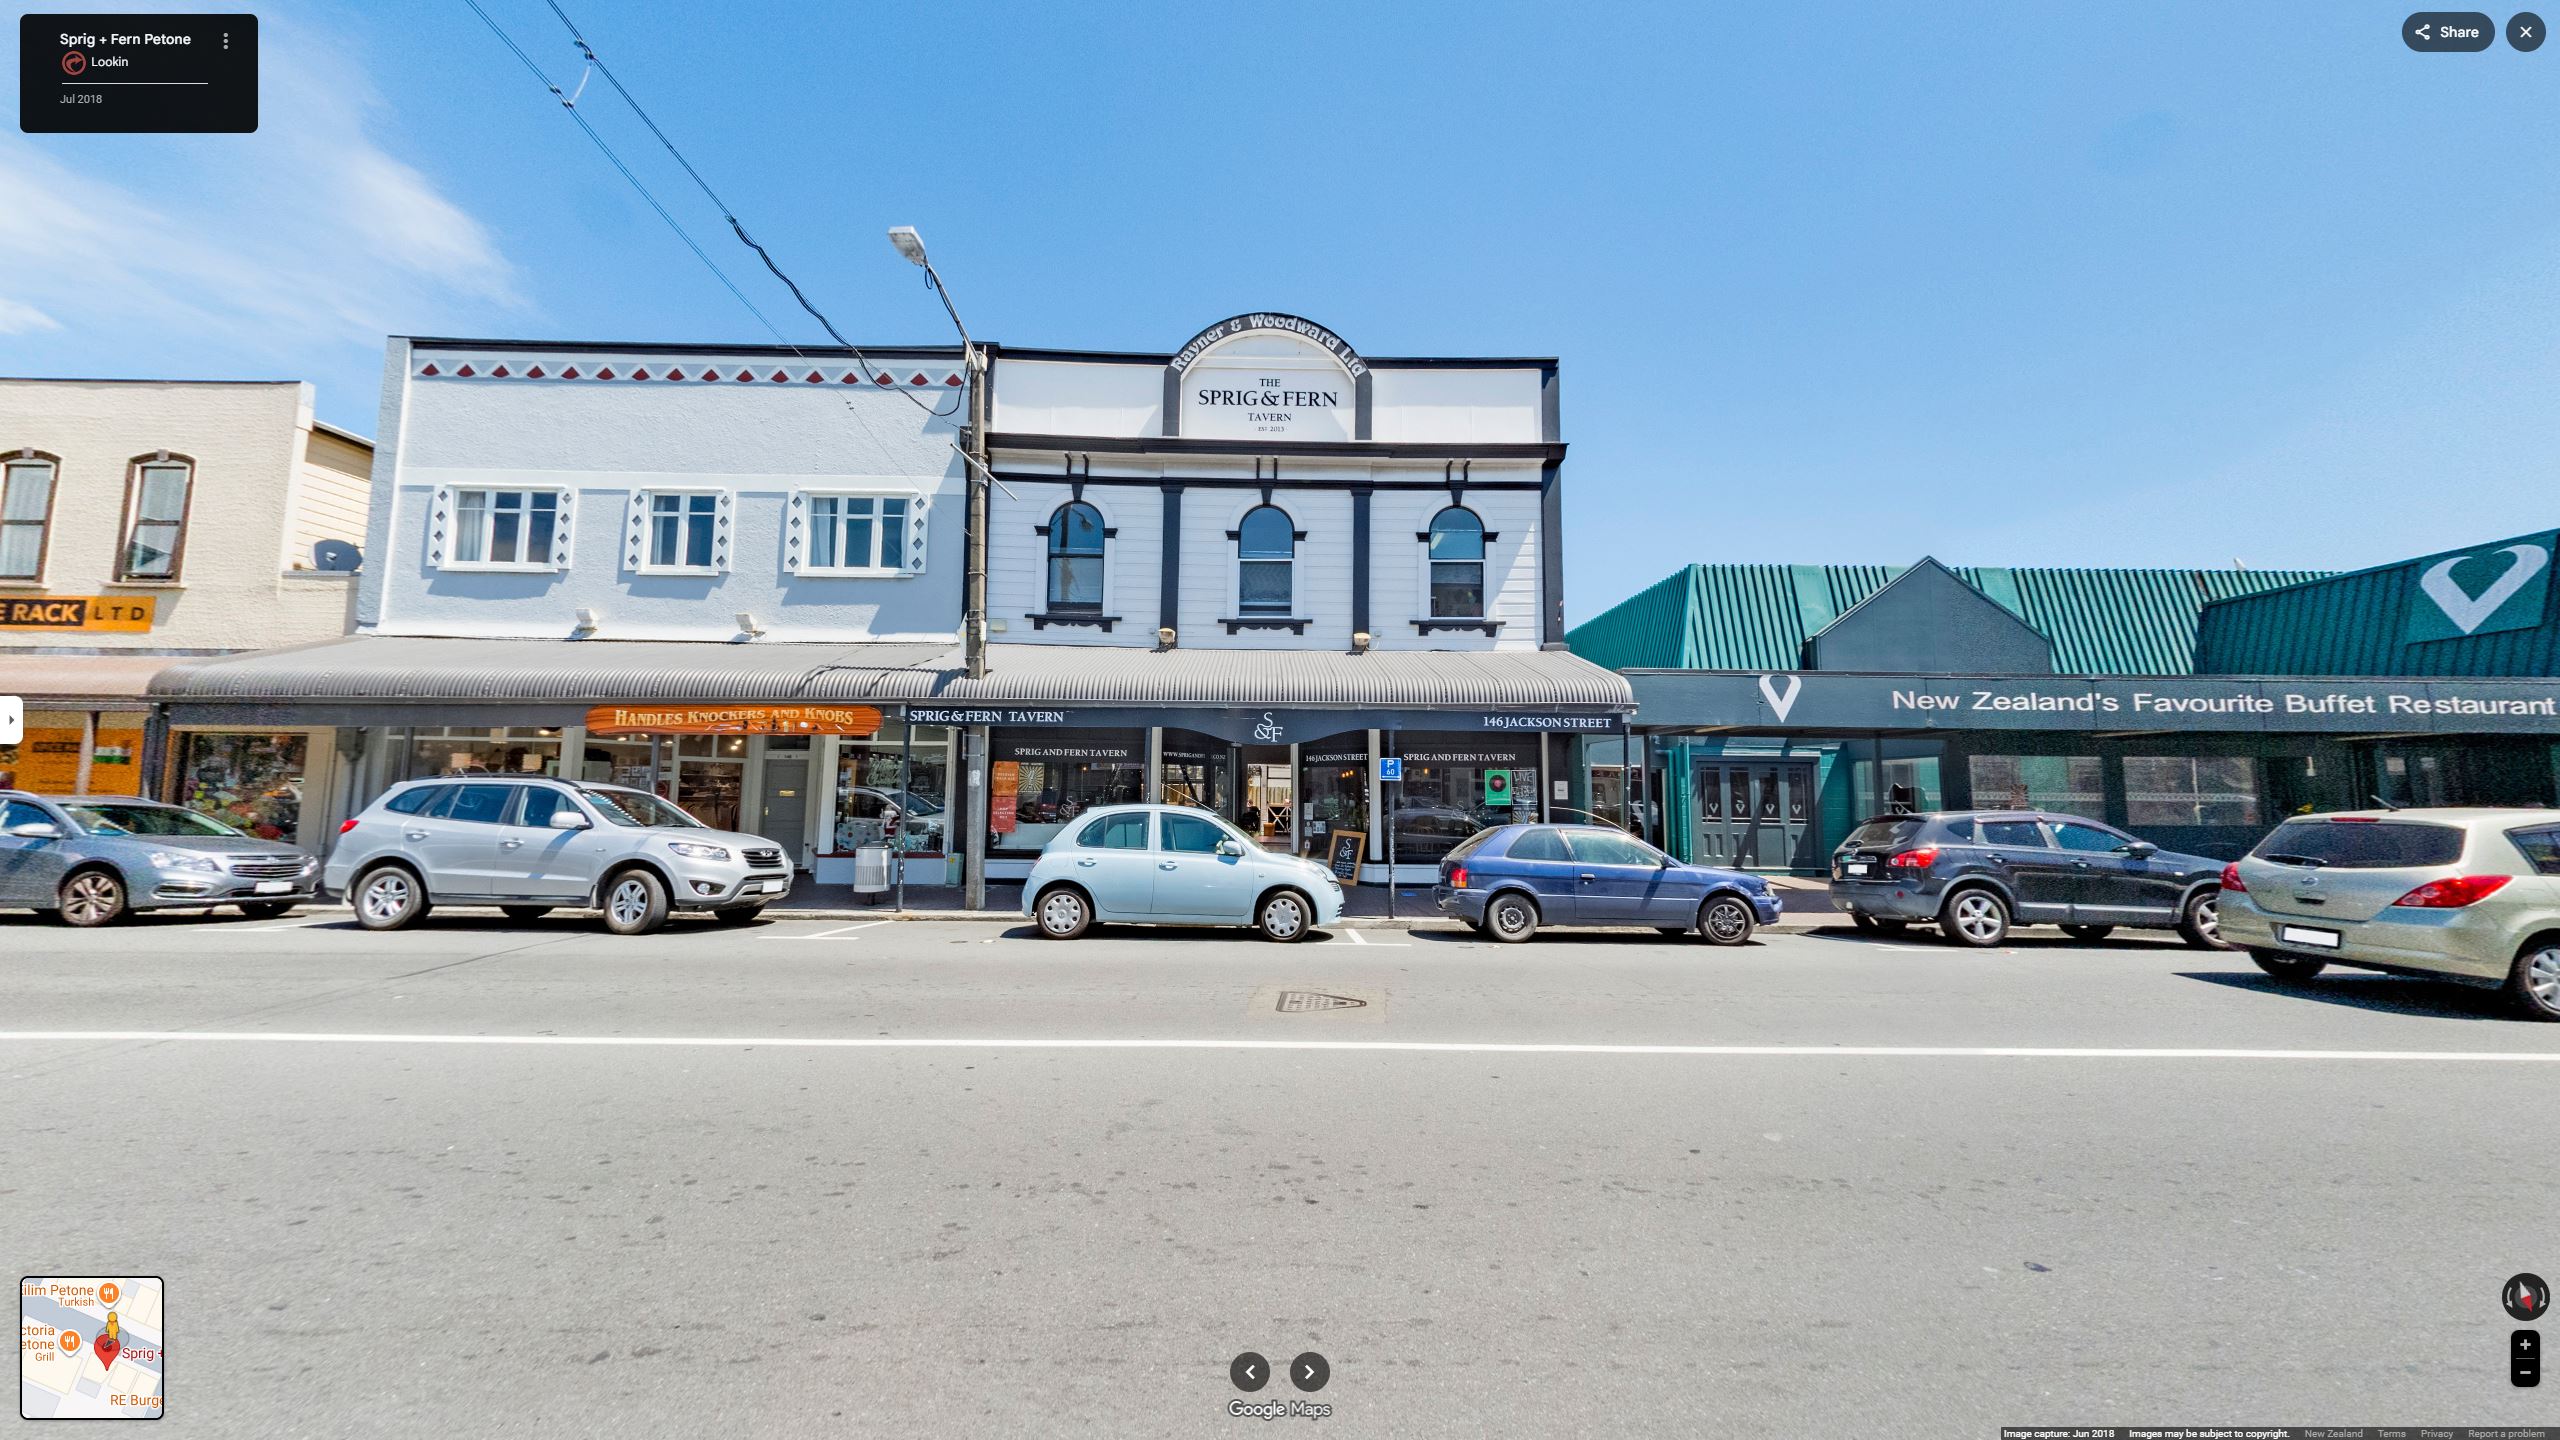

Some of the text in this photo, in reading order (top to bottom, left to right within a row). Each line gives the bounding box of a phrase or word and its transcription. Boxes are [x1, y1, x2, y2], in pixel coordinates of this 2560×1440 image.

[1171, 325, 1224, 373] Rayner
[1249, 314, 1342, 351] Woodward
[1340, 349, 1367, 377] Ltd
[1259, 378, 1281, 388] THE
[1247, 412, 1292, 422] TAVERN
[12, 603, 79, 622] RACK
[94, 606, 145, 621] LTD
[1892, 690, 2555, 716] New Zealand's Favourite Buffet Restaurant
[614, 708, 854, 726] HANDLES KNOCKERS AND KNOBS
[1009, 711, 1064, 723] TAVERN
[1502, 716, 1562, 729] JACKSON
[1564, 716, 1611, 728] STREET
[1015, 747, 1127, 758] SPRIG AND FERN TAVERN
[1403, 753, 1516, 762] SPRIG AND FERN TAVERN
[1315, 754, 1343, 763] JACKSON
[1343, 754, 1368, 762] STREET
[1387, 760, 1394, 768] P
